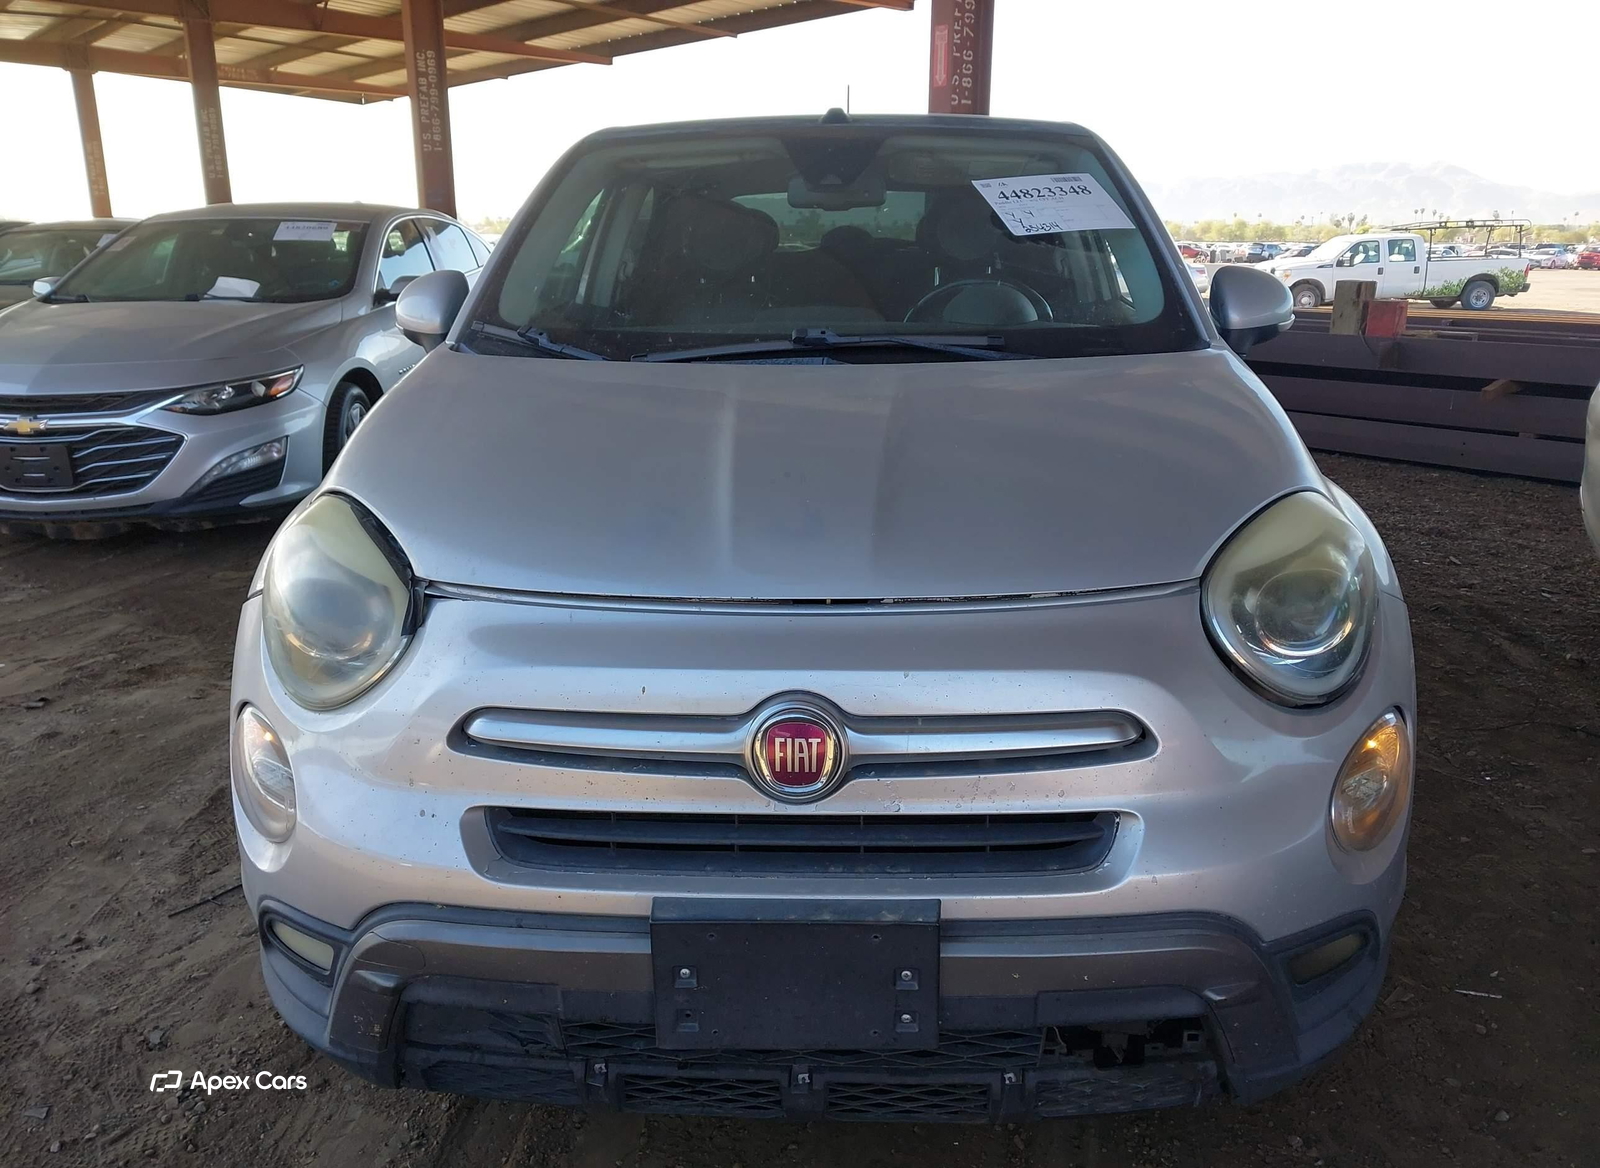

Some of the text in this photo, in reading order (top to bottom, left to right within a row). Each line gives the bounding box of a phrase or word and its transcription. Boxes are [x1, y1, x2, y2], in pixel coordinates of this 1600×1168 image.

[416, 49, 432, 151] U.S. PREFAB INC.
[998, 185, 1092, 200] 44823348
[774, 737, 821, 773] FIAT
